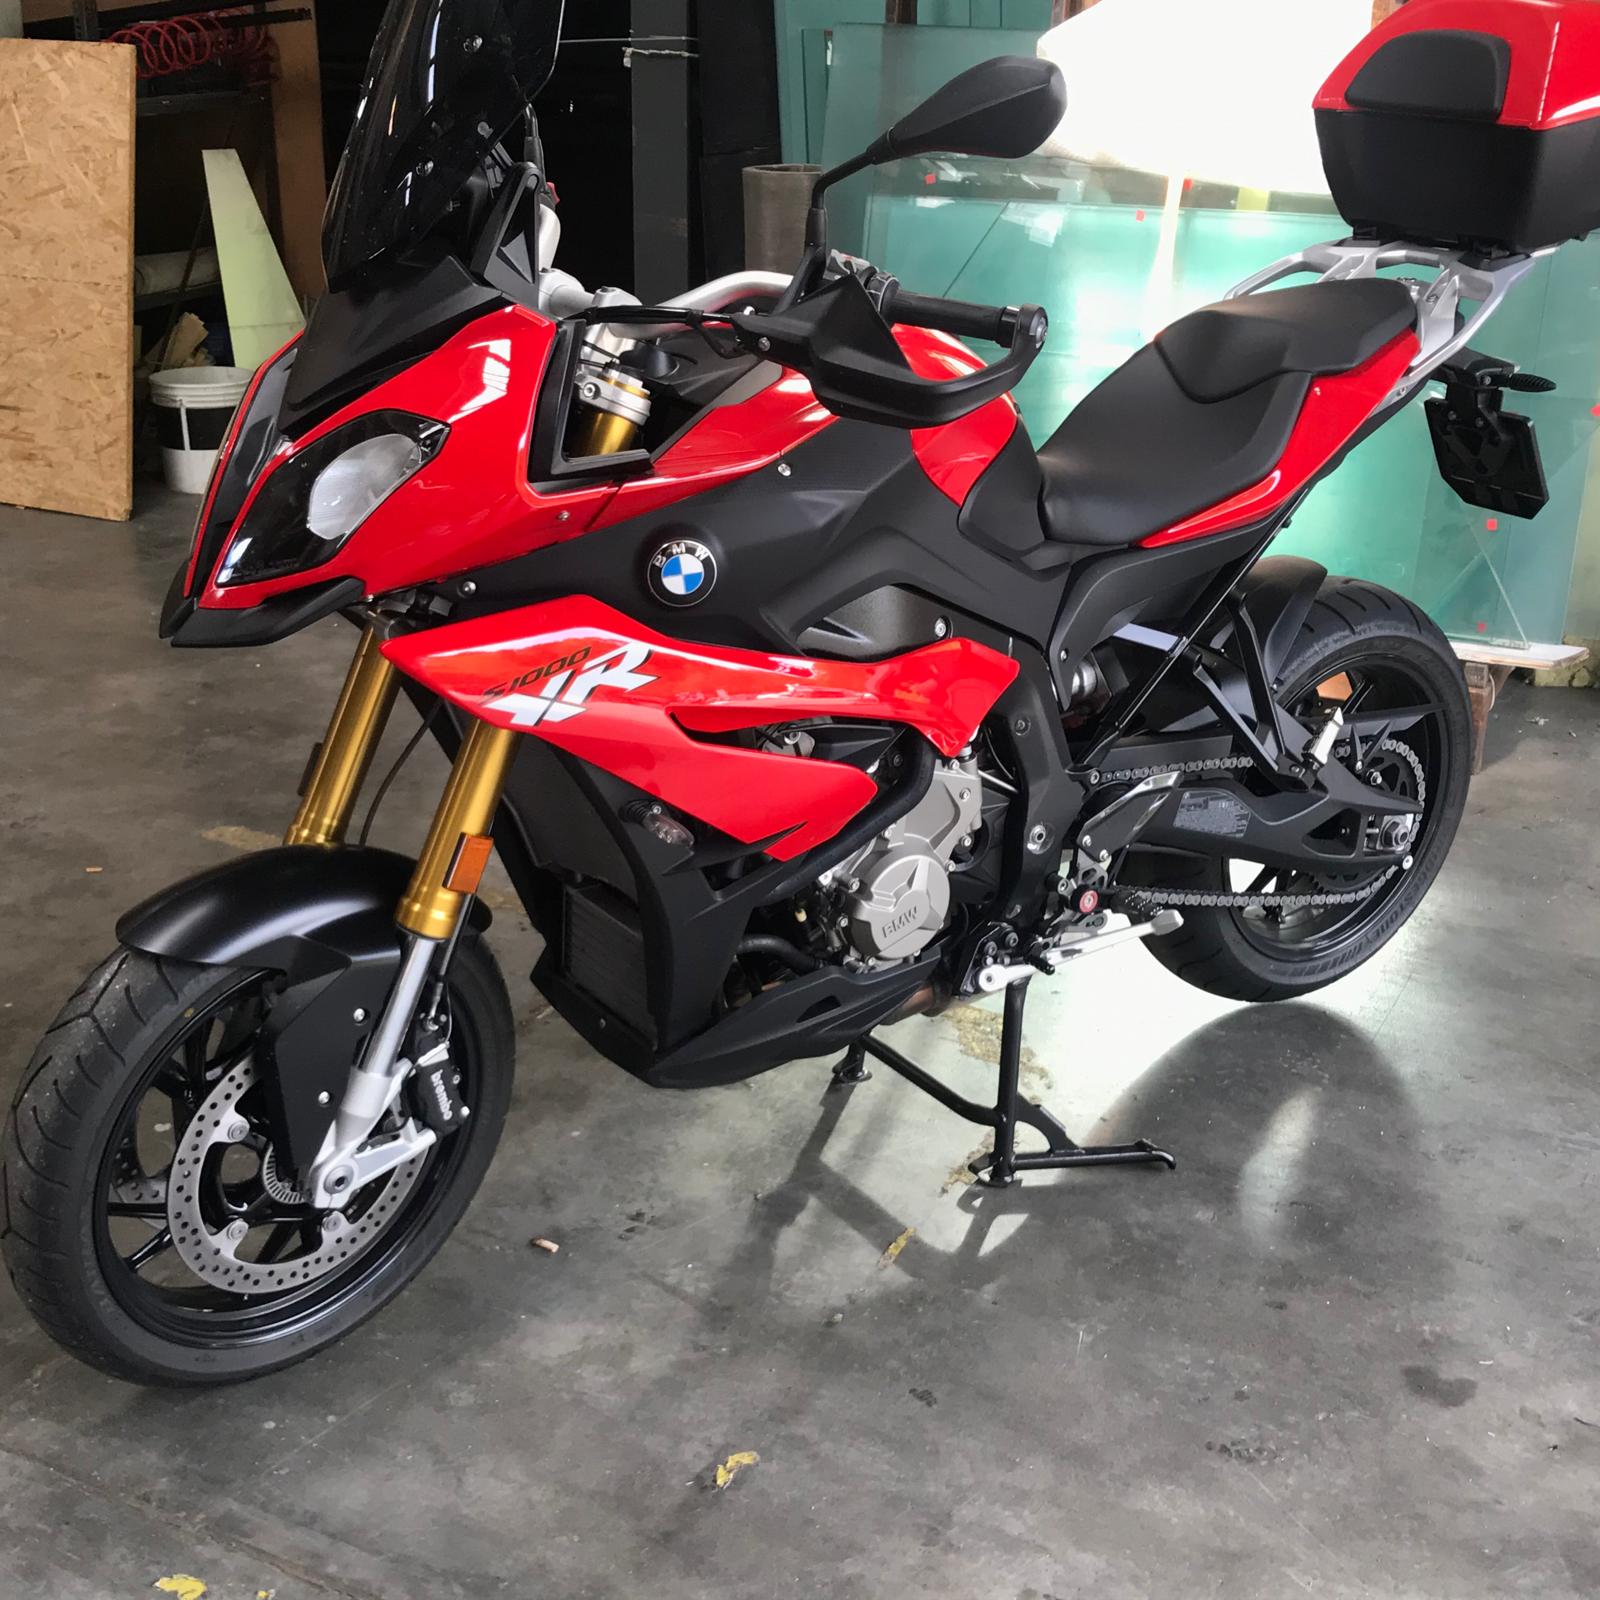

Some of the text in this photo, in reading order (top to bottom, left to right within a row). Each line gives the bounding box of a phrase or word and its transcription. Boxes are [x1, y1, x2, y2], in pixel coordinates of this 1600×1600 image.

[653, 543, 709, 568] BMW
[482, 642, 661, 727] XR
[483, 647, 592, 700] S1000
[882, 906, 918, 938] BMW
[430, 1069, 453, 1121] brembo
